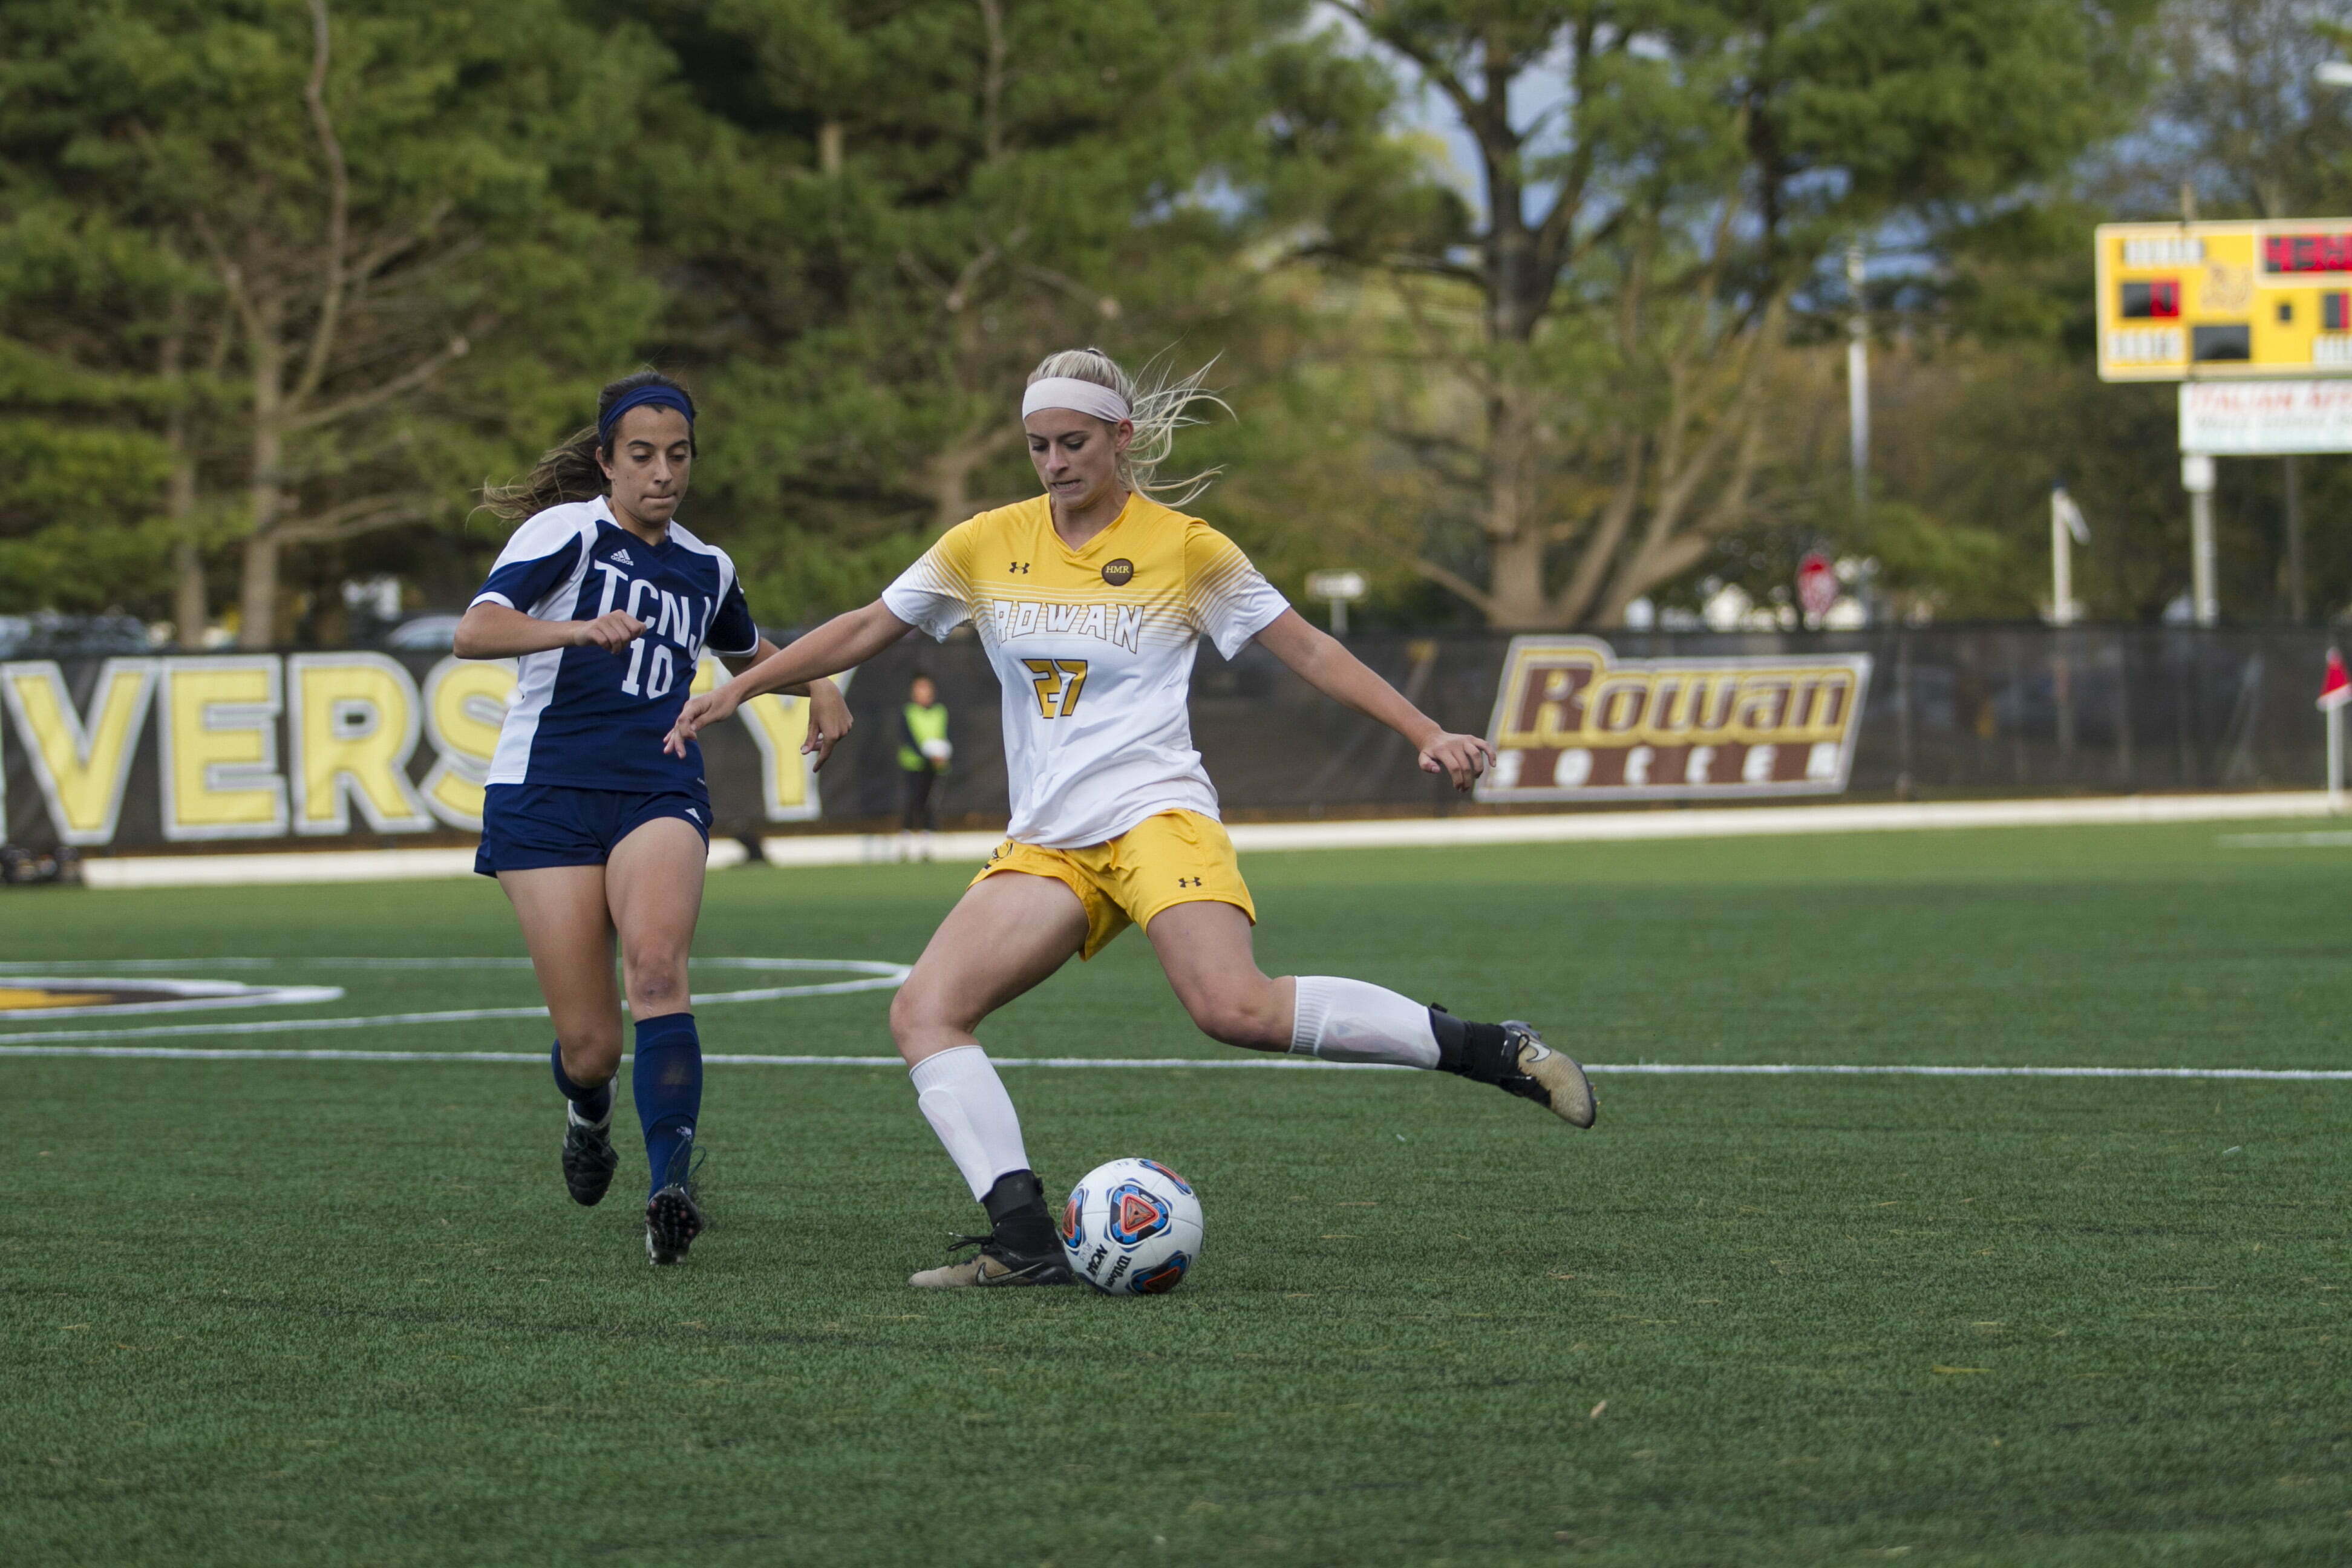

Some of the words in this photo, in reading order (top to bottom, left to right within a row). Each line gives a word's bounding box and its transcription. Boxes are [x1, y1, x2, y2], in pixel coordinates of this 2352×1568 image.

[610, 555, 634, 567] adidas
[1105, 565, 1130, 575] HMR
[594, 559, 711, 662] TCNJ
[992, 599, 1145, 655] ROWAN
[621, 638, 673, 699] 10
[1021, 659, 1088, 719] 27
[1500, 648, 1855, 745] Rowan
[1086, 1243, 1108, 1276] NCAA
